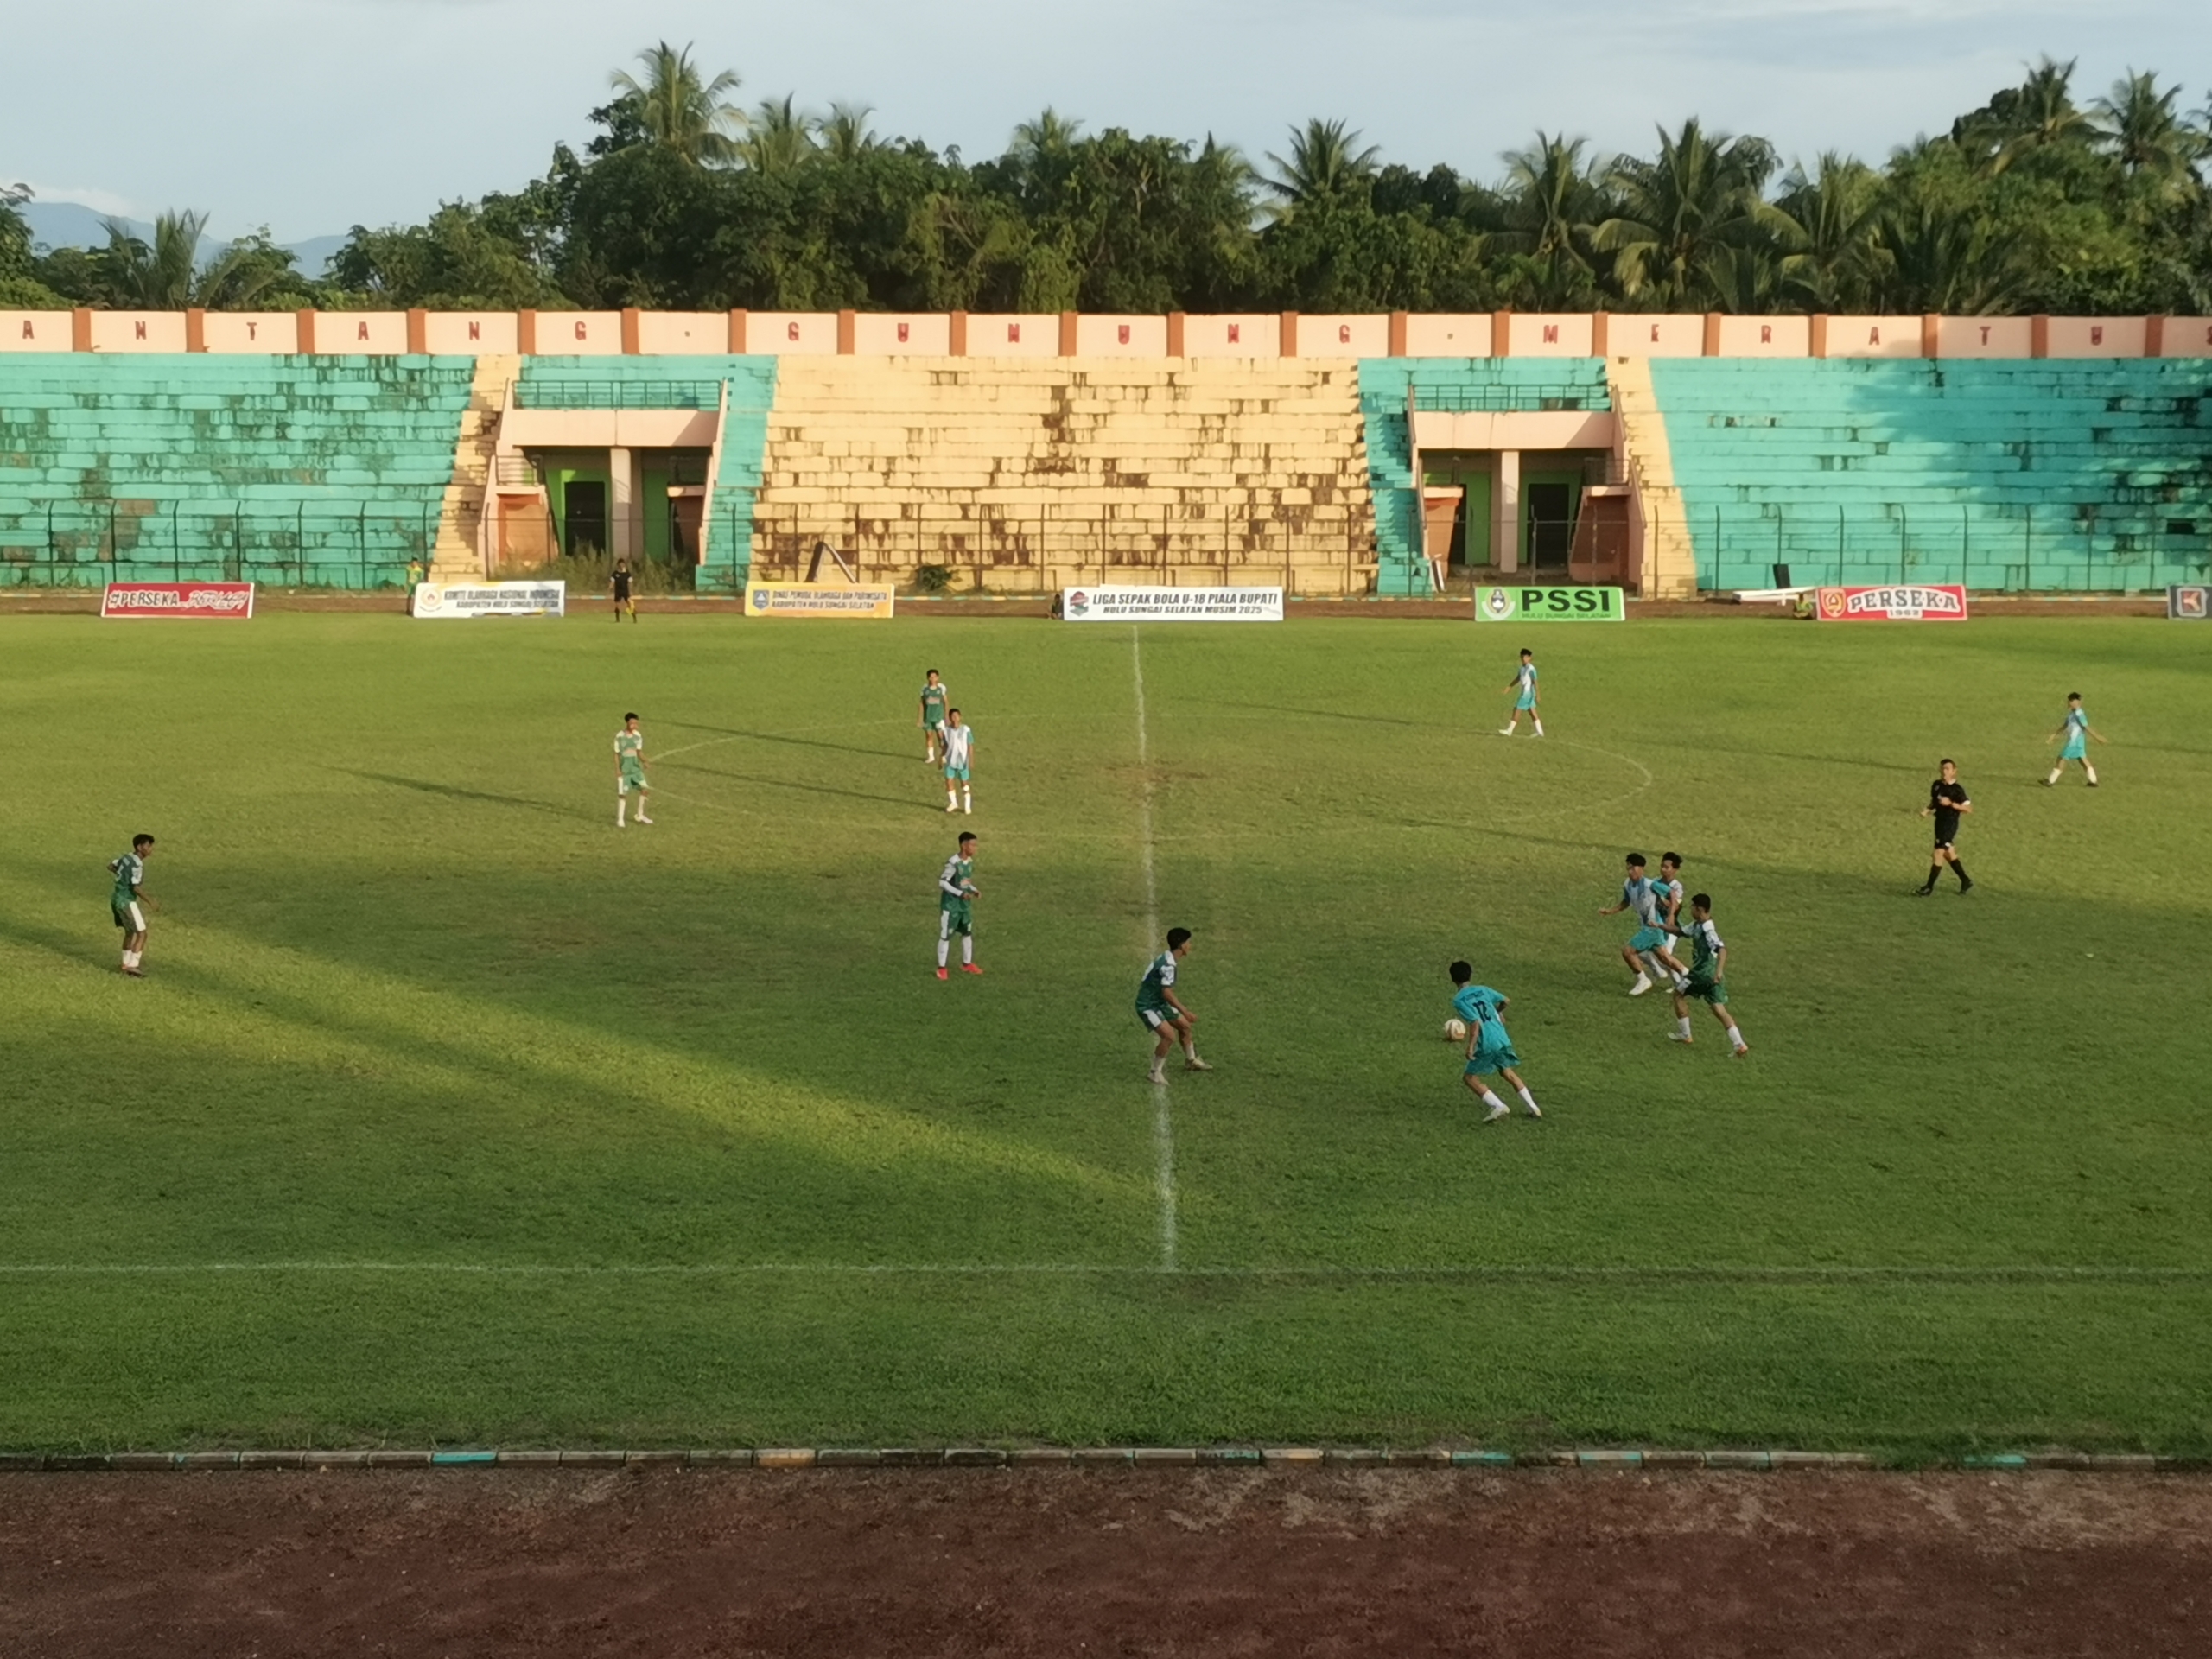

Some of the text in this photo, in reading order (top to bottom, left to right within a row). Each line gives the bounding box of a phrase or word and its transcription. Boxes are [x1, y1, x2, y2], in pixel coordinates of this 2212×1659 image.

[1093, 593, 1278, 605] LIGA SEPAK BOLA U-18 PIALA BUPATI
[1522, 589, 1610, 612] PSSI
[1850, 589, 1957, 610] PERSEKA
[1103, 606, 1262, 614] HULU SUNGAI SELATAN MUSIM 2025
